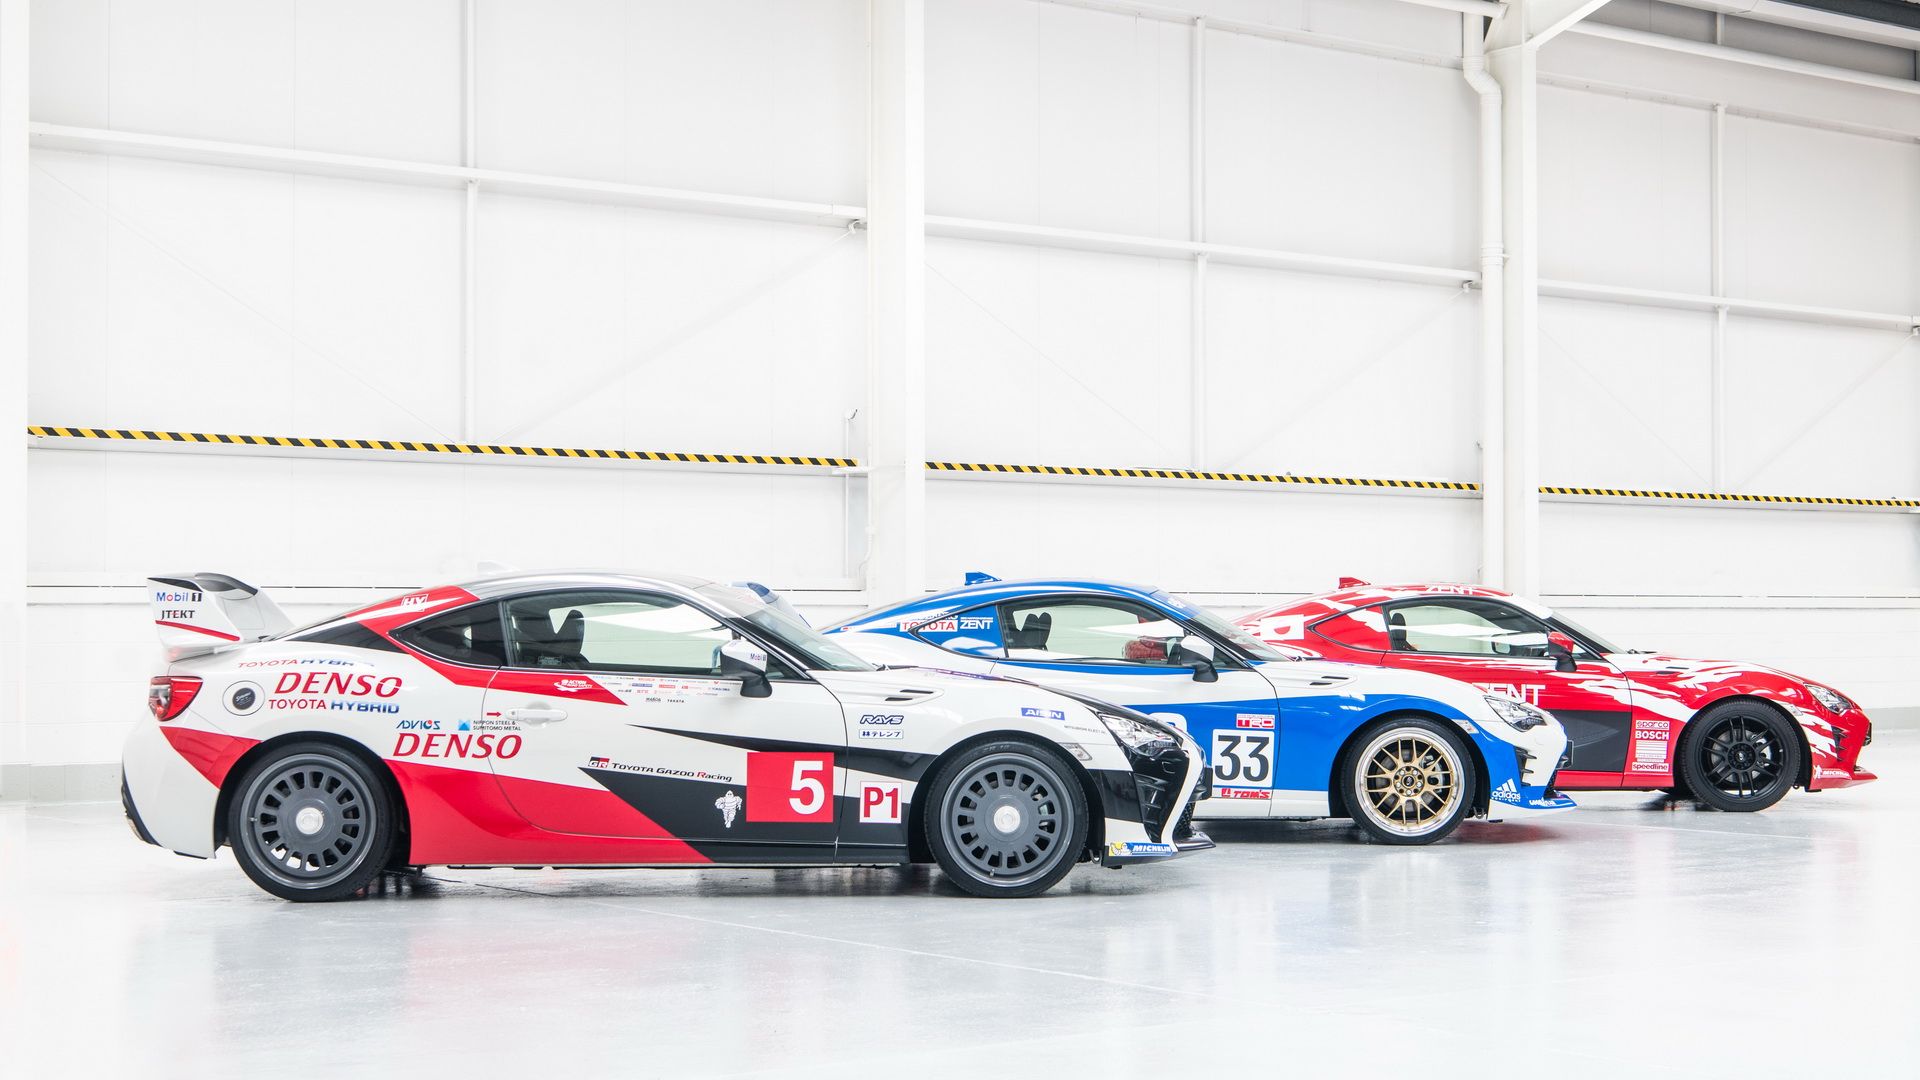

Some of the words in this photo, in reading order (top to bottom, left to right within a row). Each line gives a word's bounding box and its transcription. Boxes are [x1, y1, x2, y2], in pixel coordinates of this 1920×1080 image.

[156, 592, 189, 602] Mobil
[161, 610, 195, 620] JTEKT
[960, 620, 993, 630] ZENT
[238, 659, 298, 668] TOYOTA
[274, 672, 403, 698] DENSO
[269, 699, 327, 710] TOYOTA
[331, 701, 400, 714] HYBRID
[860, 714, 904, 725] RAYS
[396, 720, 440, 730] ADVICS
[1635, 730, 1669, 740] BOSCH
[392, 732, 522, 760] DENSO
[1215, 735, 1270, 782] 33
[611, 762, 654, 773] TOYOTA
[656, 767, 695, 777] GAZOO
[696, 771, 733, 782] Racing
[788, 760, 825, 815] 5
[1233, 789, 1270, 799] TOM'S
[1491, 790, 1520, 799] adidas
[863, 786, 899, 818] P1
